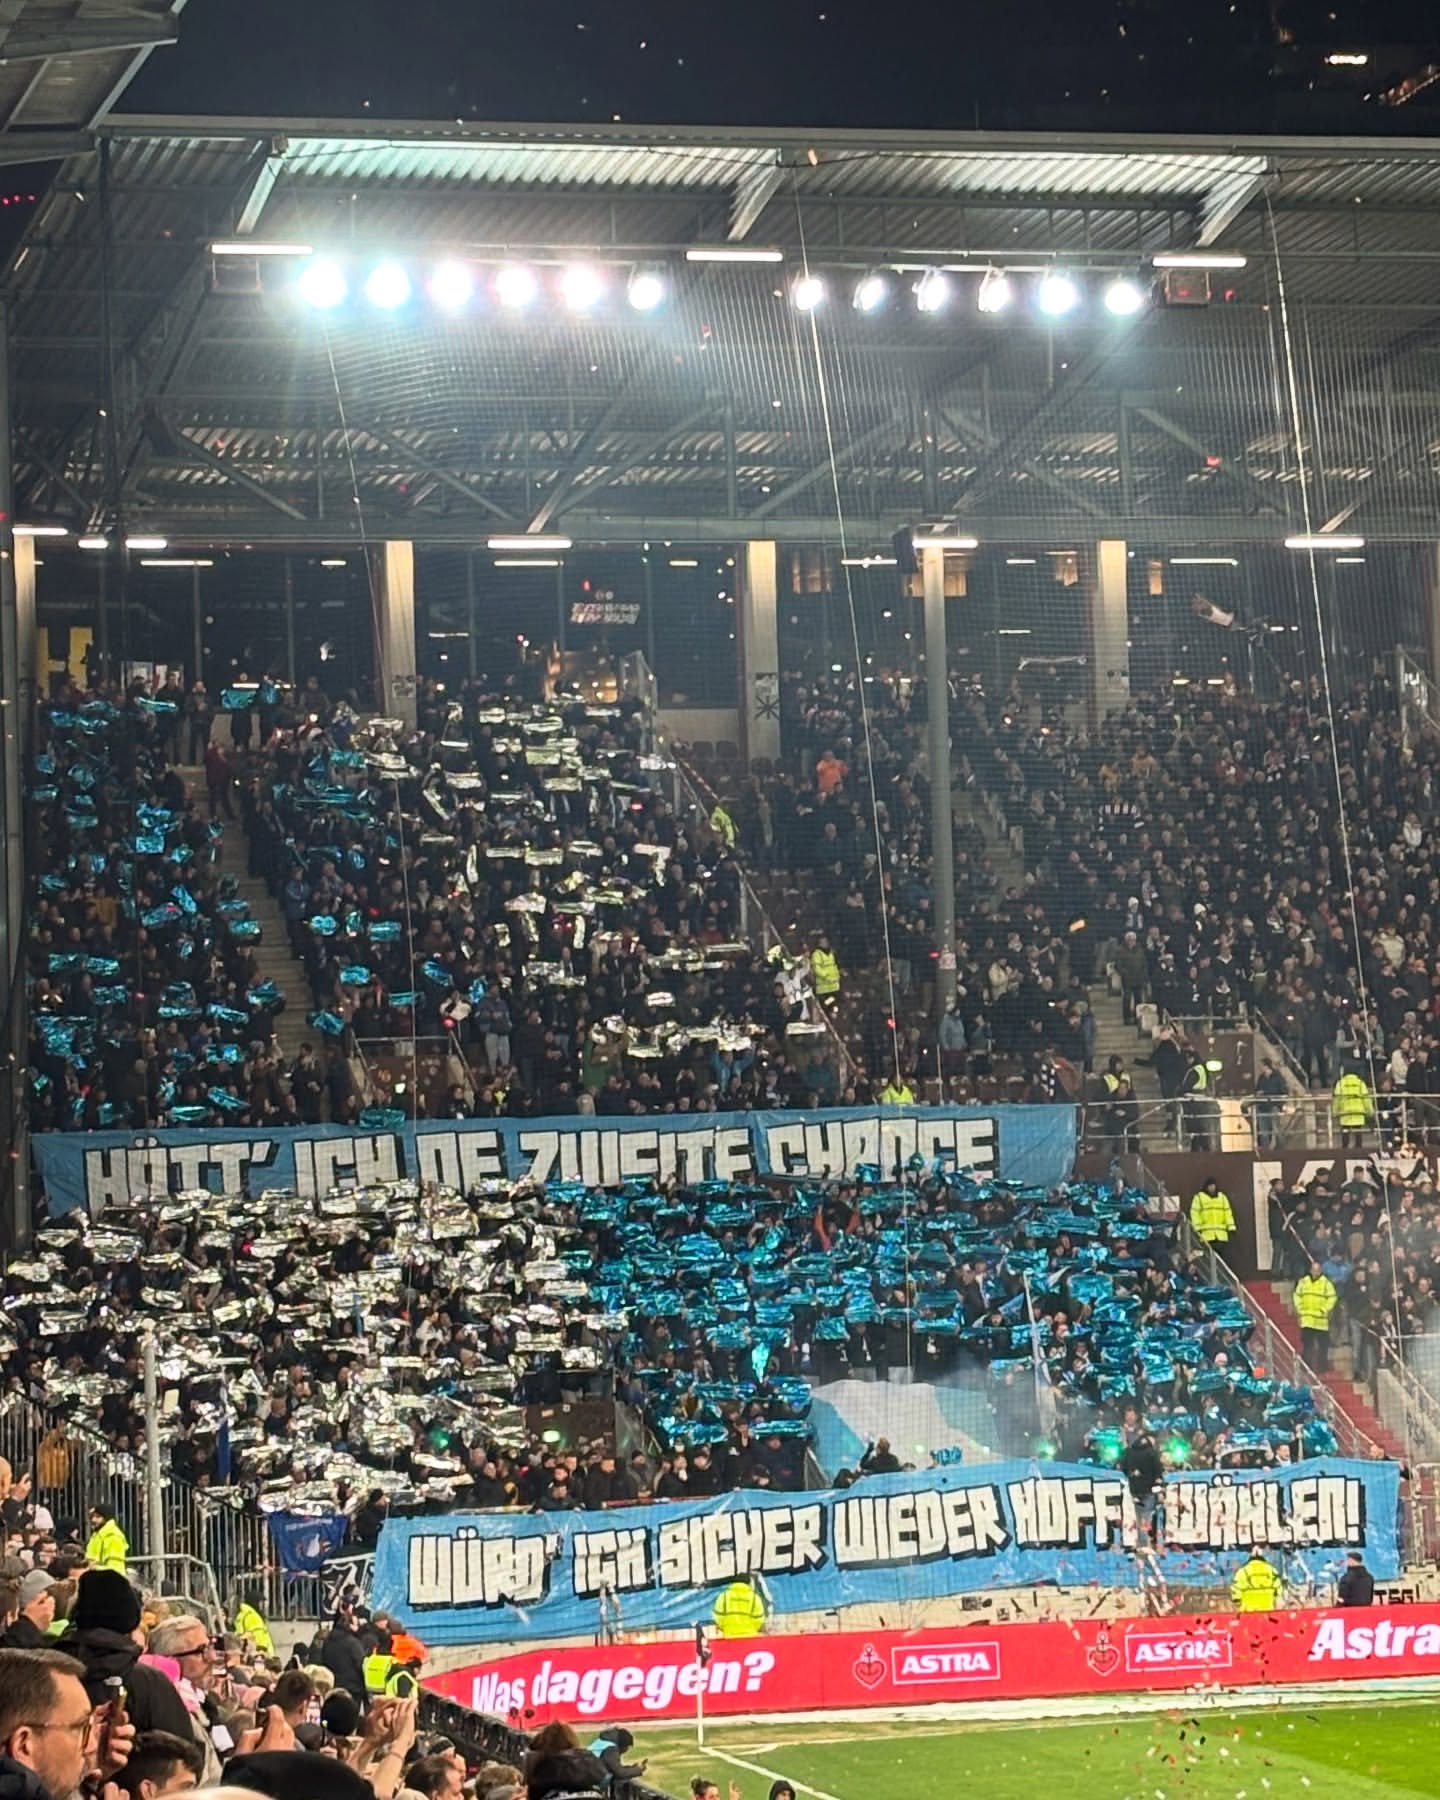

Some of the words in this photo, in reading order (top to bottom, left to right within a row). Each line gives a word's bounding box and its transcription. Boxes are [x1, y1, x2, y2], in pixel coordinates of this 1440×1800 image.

[84, 1136, 274, 1217] HÄTT'
[293, 1131, 402, 1200] ICH
[519, 1128, 753, 1188] ZWEITE
[766, 1117, 997, 1184] CHANCE
[573, 1527, 652, 1597] ICH
[658, 1503, 834, 1589] SICHER
[833, 1484, 1010, 1567] WIEDER
[1164, 1473, 1365, 1548] WÄHLEN!
[901, 1652, 991, 1675] ASTRA
[1134, 1640, 1221, 1663] ASTRA
[1308, 1618, 1440, 1661] Astra
[472, 1671, 526, 1713] Was
[531, 1650, 776, 1714] dagegen?
